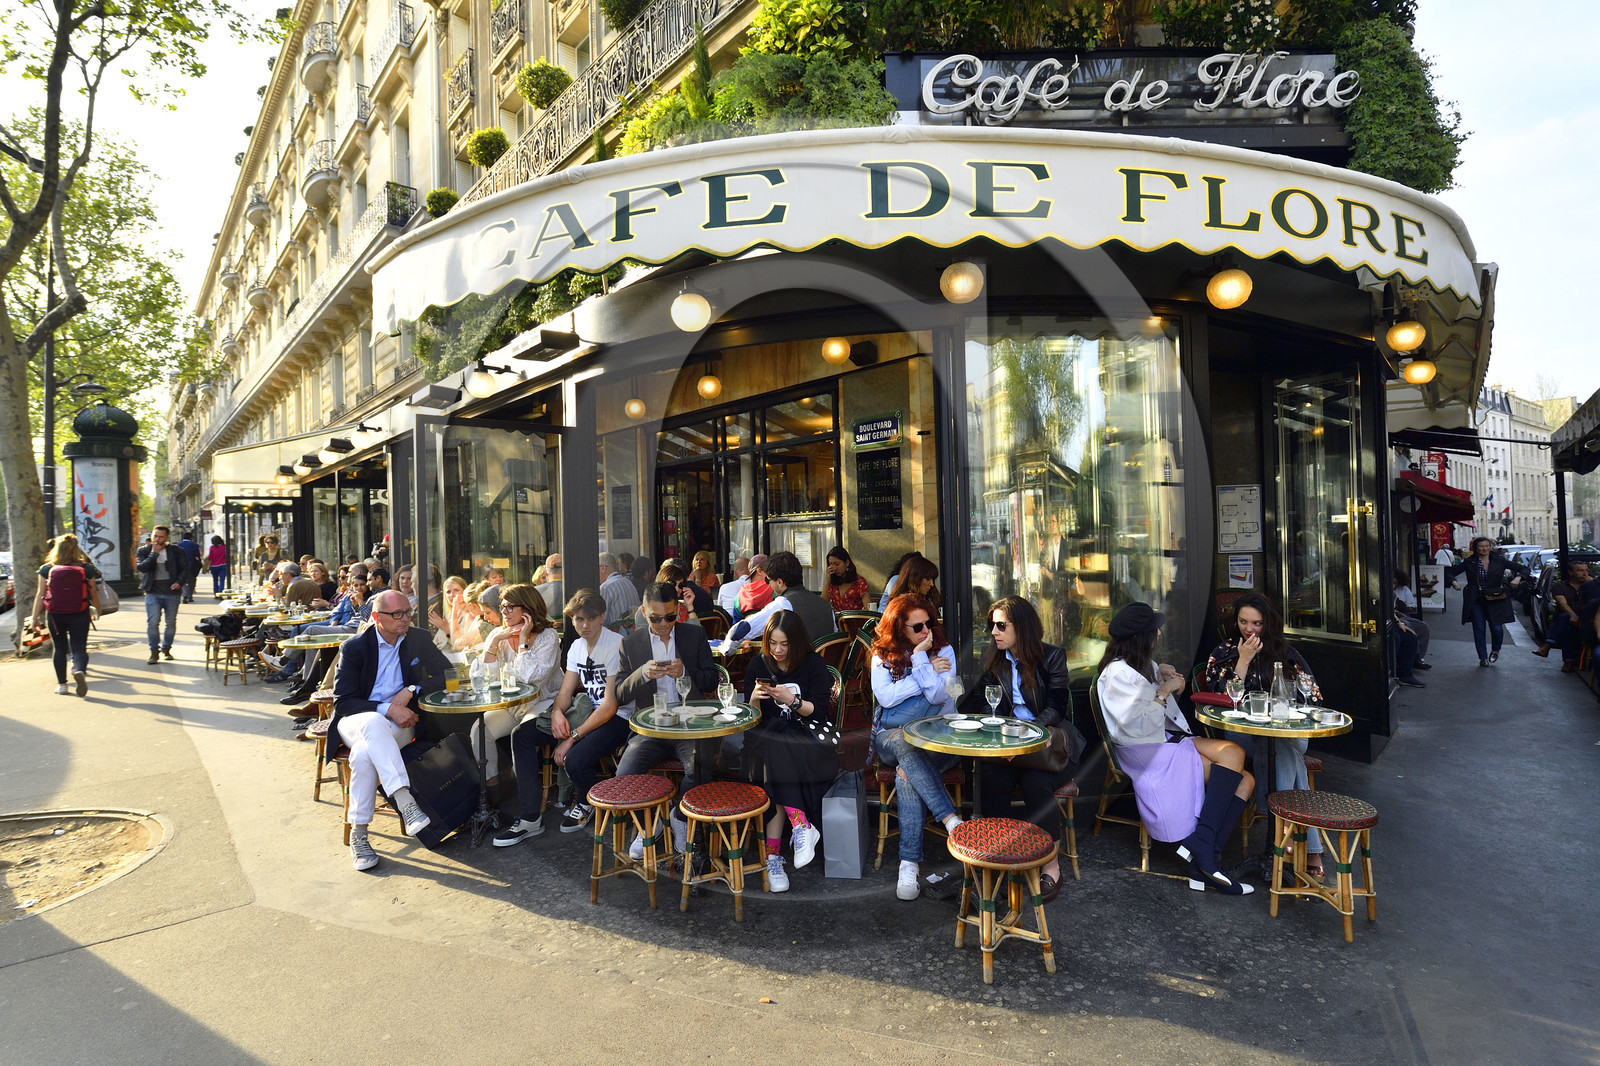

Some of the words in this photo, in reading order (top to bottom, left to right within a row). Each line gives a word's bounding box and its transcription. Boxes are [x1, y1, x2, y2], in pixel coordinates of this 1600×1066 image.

[922, 54, 1080, 126] Café
[1103, 67, 1170, 111] de
[1194, 51, 1362, 112] Flore
[471, 167, 789, 270] CAFE
[860, 160, 1054, 220] DE
[1116, 166, 1429, 267] FLORE
[859, 420, 892, 433] BOULEVARD
[856, 433, 872, 443] SAINT
[872, 429, 897, 440] GERMAIN
[872, 460, 879, 470] DE
[882, 459, 898, 468] FLORE
[874, 478, 898, 487] CHOCOLAT
